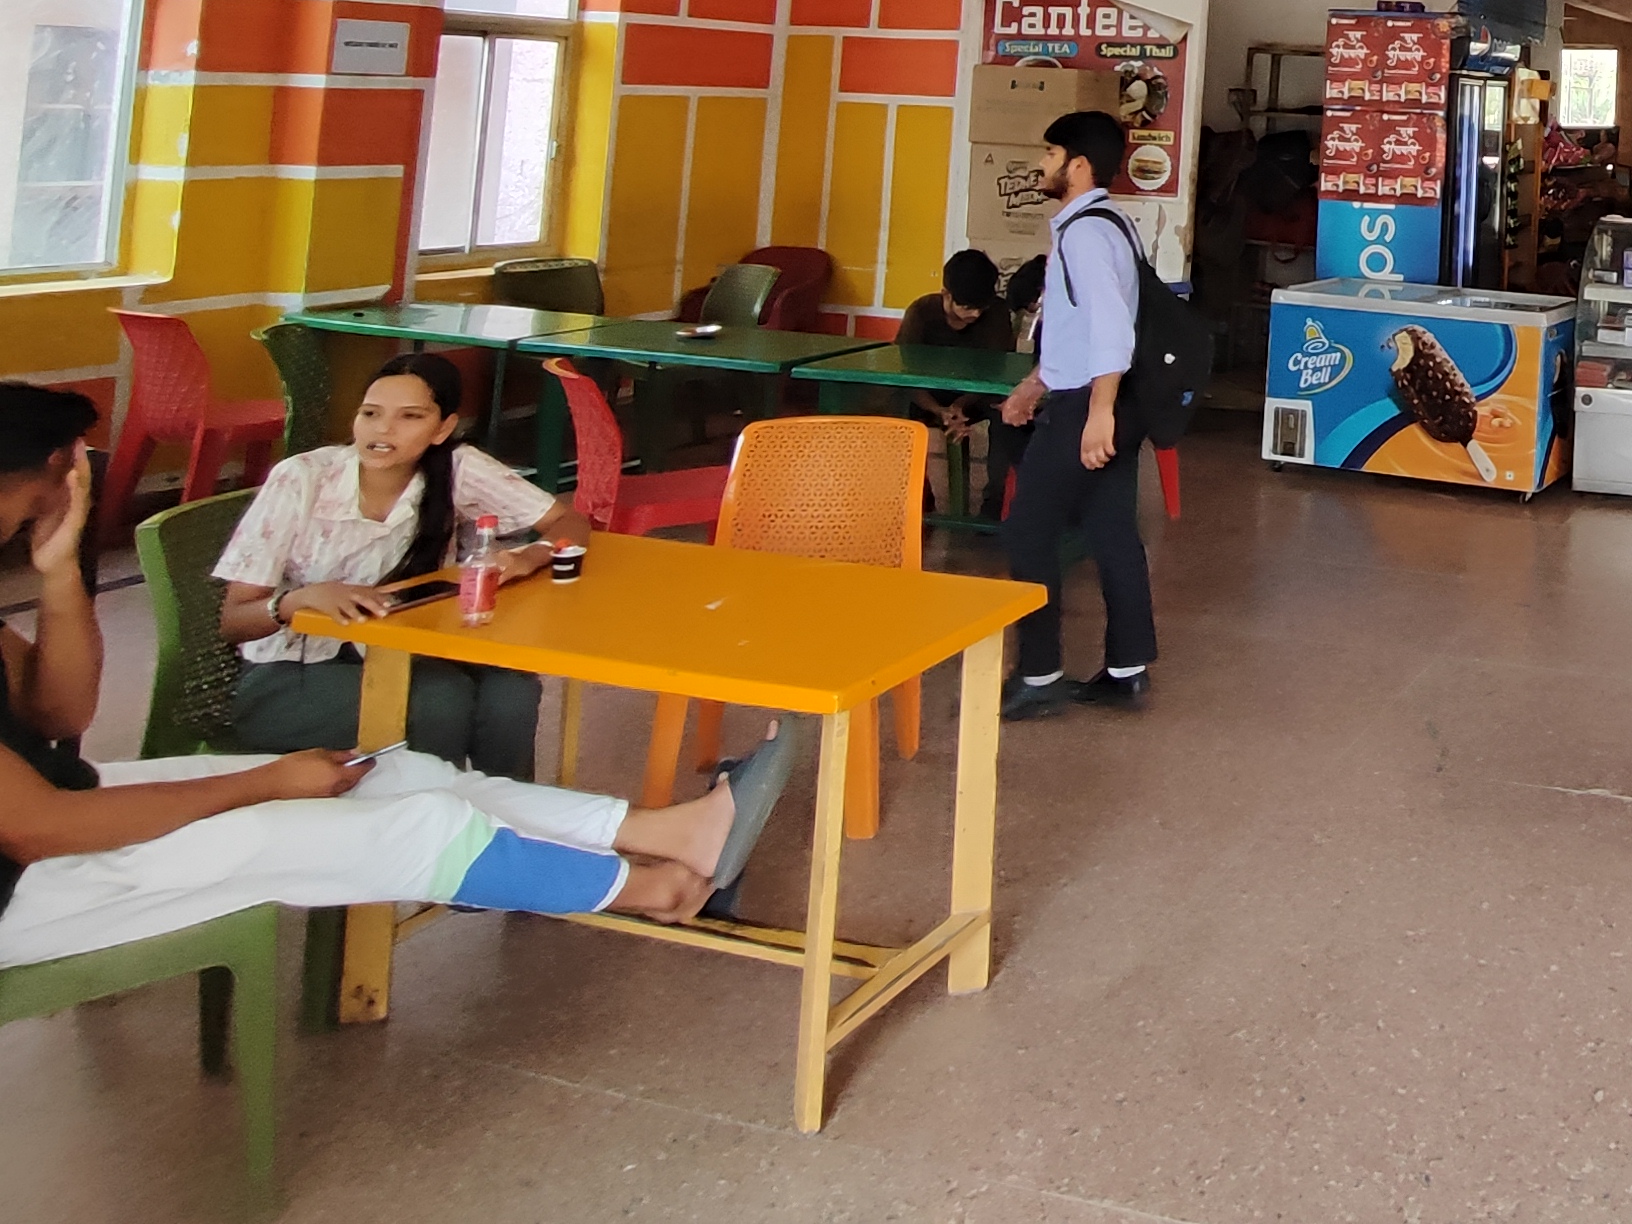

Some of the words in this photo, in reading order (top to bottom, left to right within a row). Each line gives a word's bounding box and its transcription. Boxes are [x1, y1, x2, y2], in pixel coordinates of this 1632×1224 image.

[1004, 42, 1043, 53] Special
[1048, 43, 1070, 54] TEA
[1100, 45, 1140, 57] Special
[1145, 45, 1174, 57] Thali
[1288, 352, 1341, 371] Cream
[1299, 367, 1331, 388] Bell
